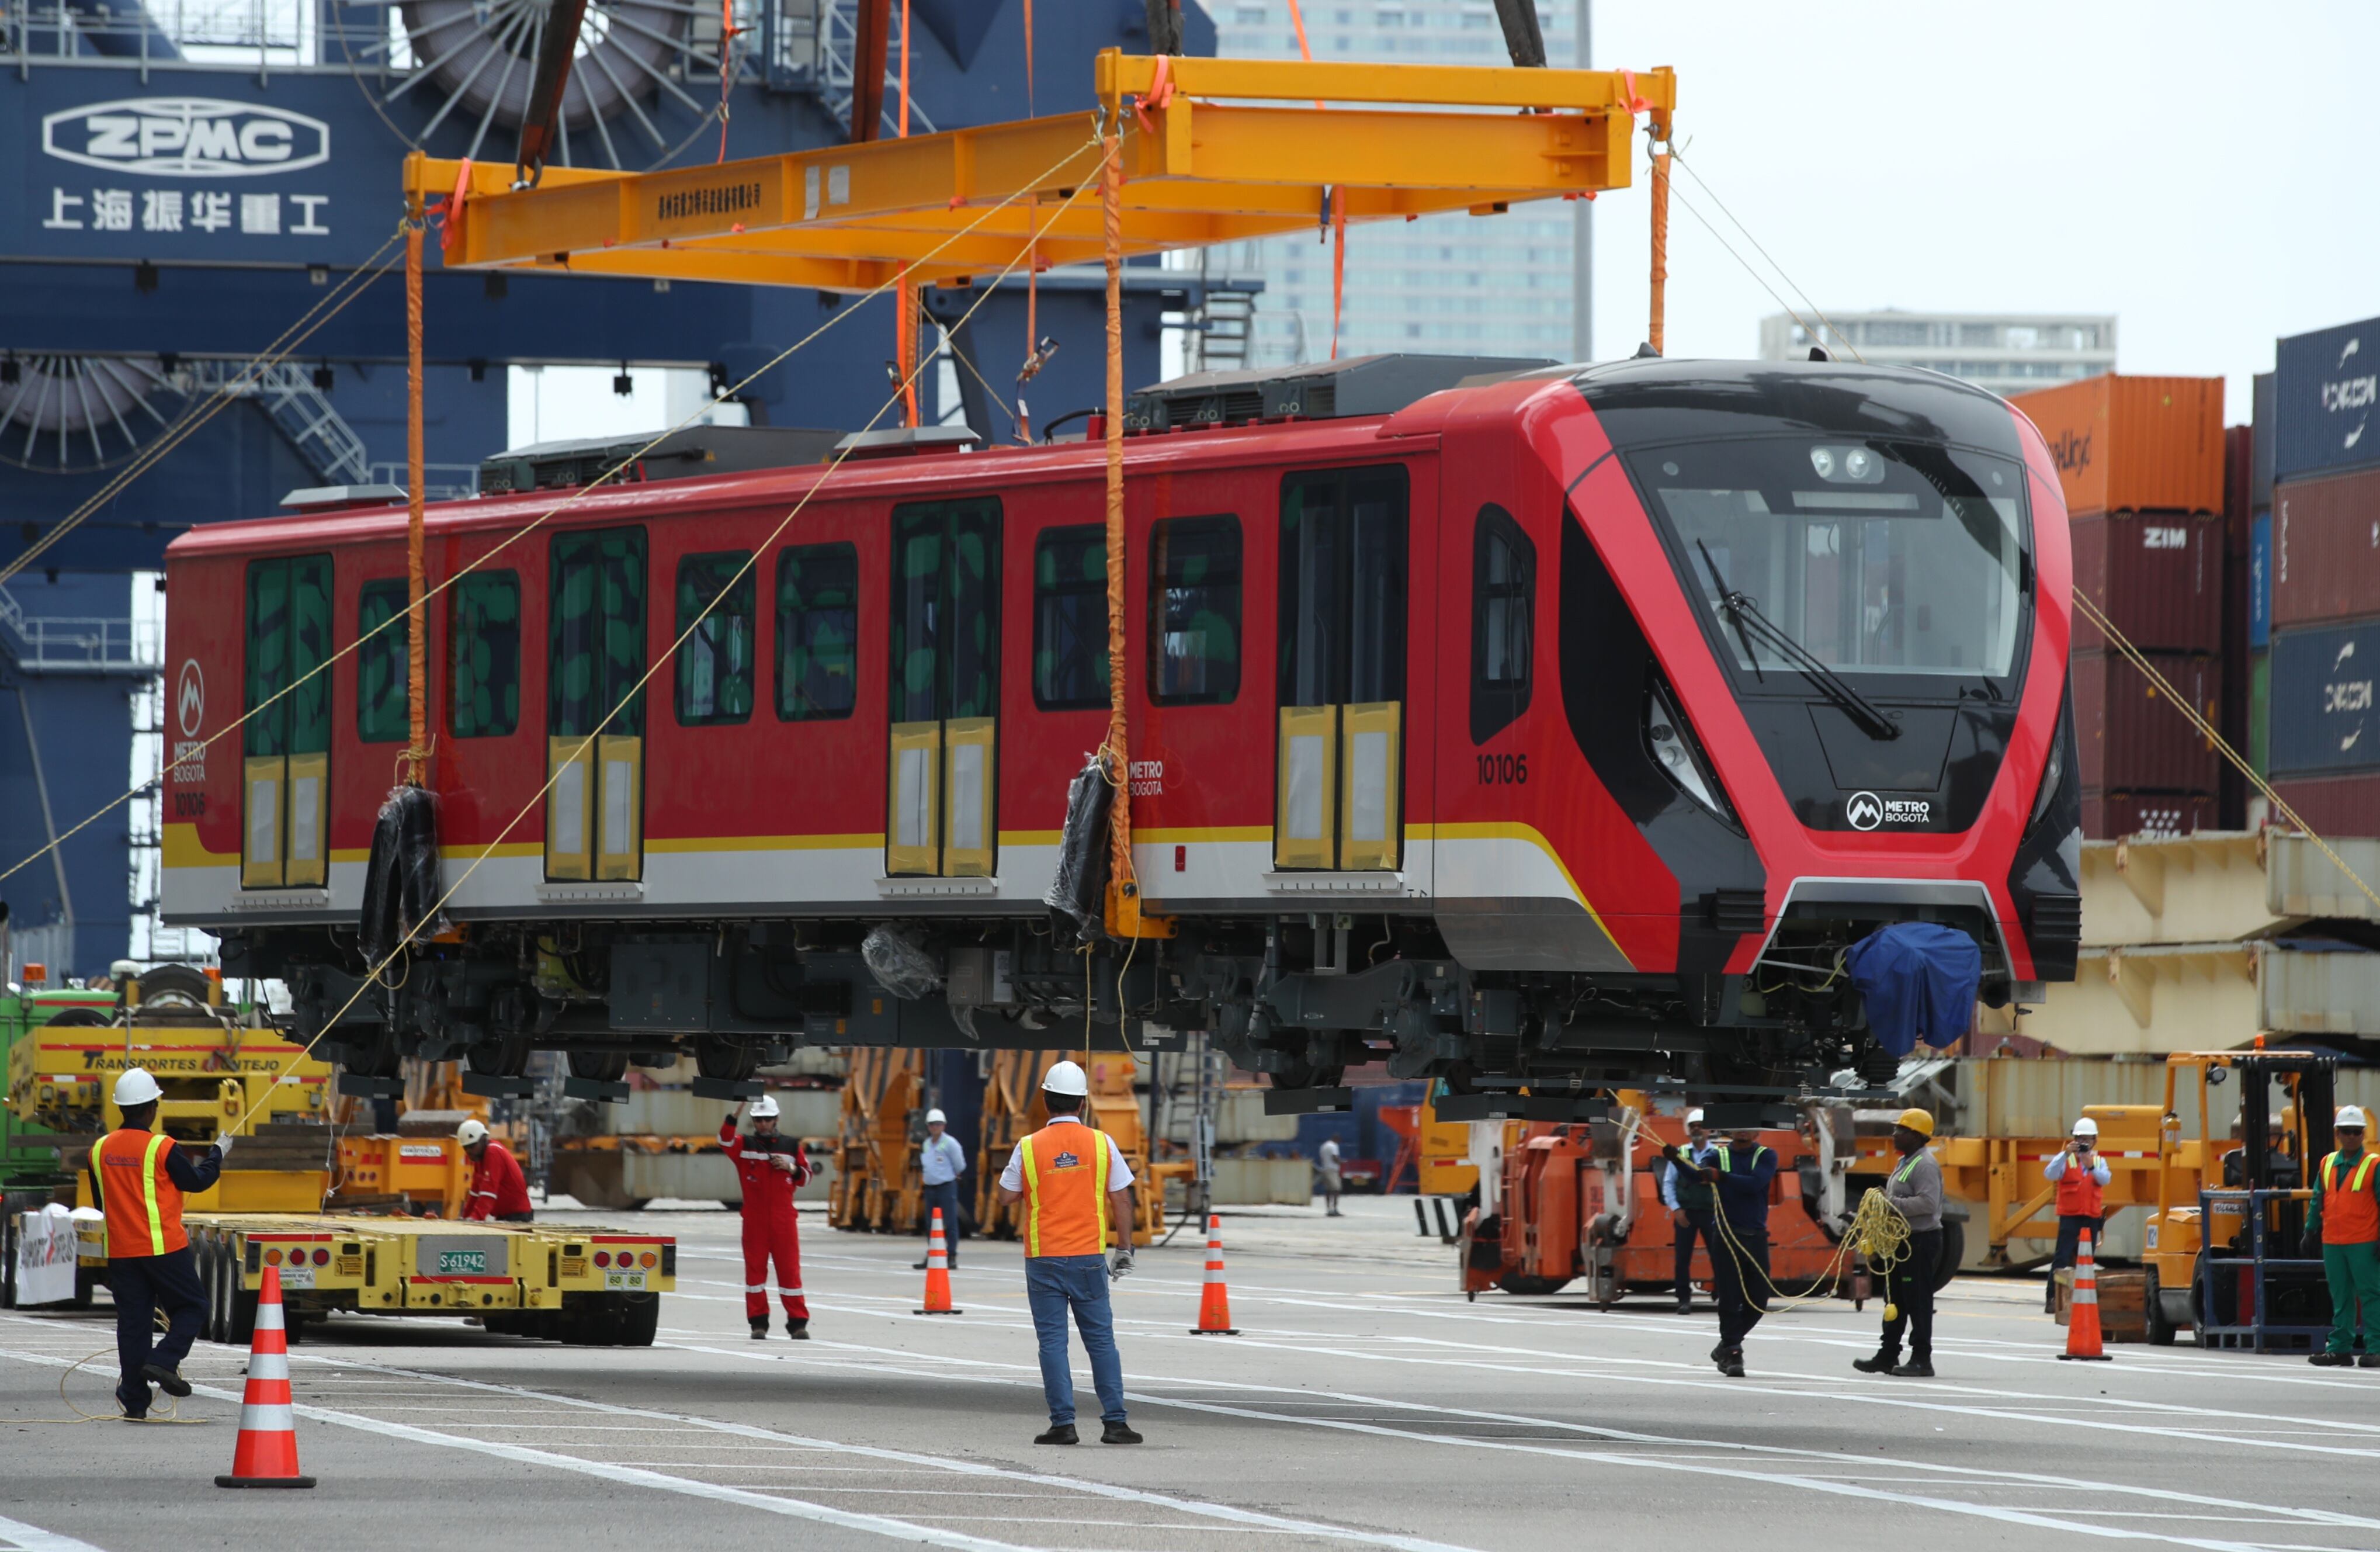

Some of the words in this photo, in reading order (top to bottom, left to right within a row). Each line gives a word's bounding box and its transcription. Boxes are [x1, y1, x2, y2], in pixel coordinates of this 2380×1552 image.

[86, 116, 293, 161] ZPMC
[2143, 528, 2187, 549] ZIM
[174, 741, 206, 762] METRO
[1129, 761, 1163, 778] METRO
[1476, 753, 1528, 785] 10106
[175, 792, 206, 816] 10106
[1885, 801, 1930, 813] METRO
[83, 1050, 196, 1071] TRANSPORTES
